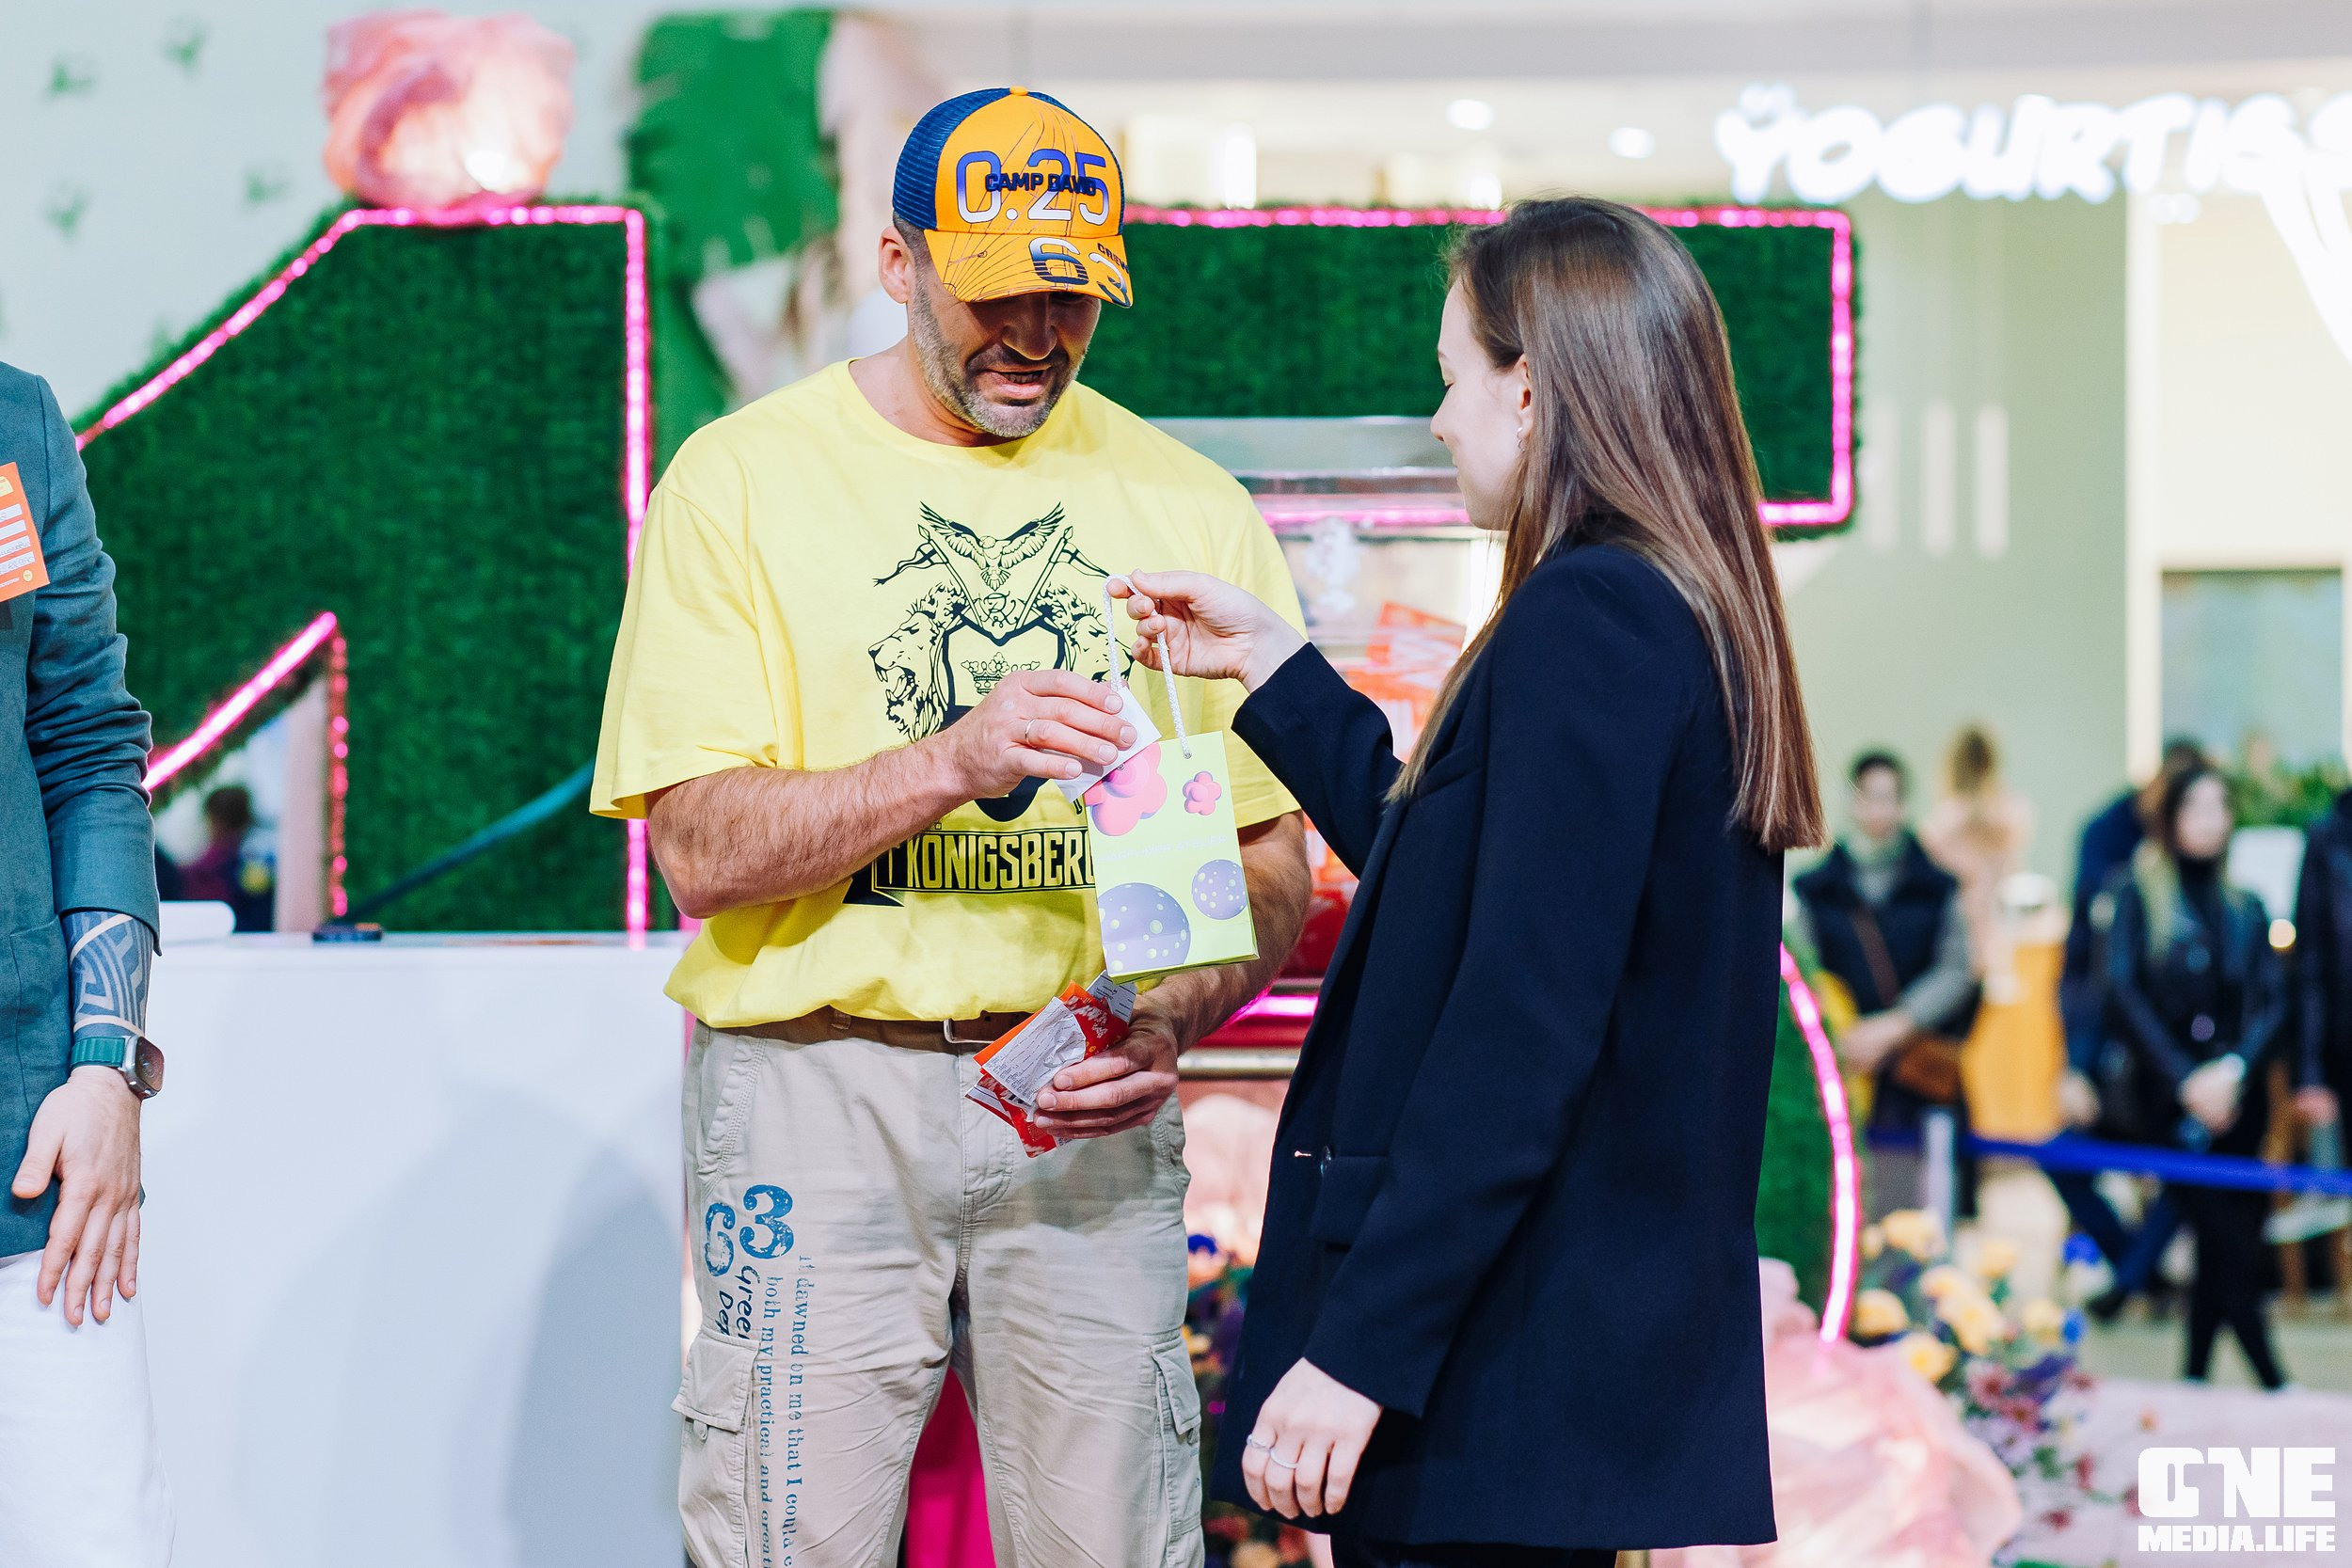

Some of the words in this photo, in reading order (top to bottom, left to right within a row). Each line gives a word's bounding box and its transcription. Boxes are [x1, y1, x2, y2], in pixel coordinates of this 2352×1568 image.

[956, 148, 1110, 226] 0.25
[985, 172, 1043, 192] CAMP
[1048, 173, 1097, 196] DAVID
[763, 1276, 783, 1319] both
[790, 1278, 815, 1355] dawned
[759, 1326, 774, 1356] my
[789, 1363, 804, 1386] on
[788, 1394, 803, 1421] me
[787, 1428, 805, 1470] that
[759, 1465, 772, 1503] and
[786, 1478, 803, 1487] I
